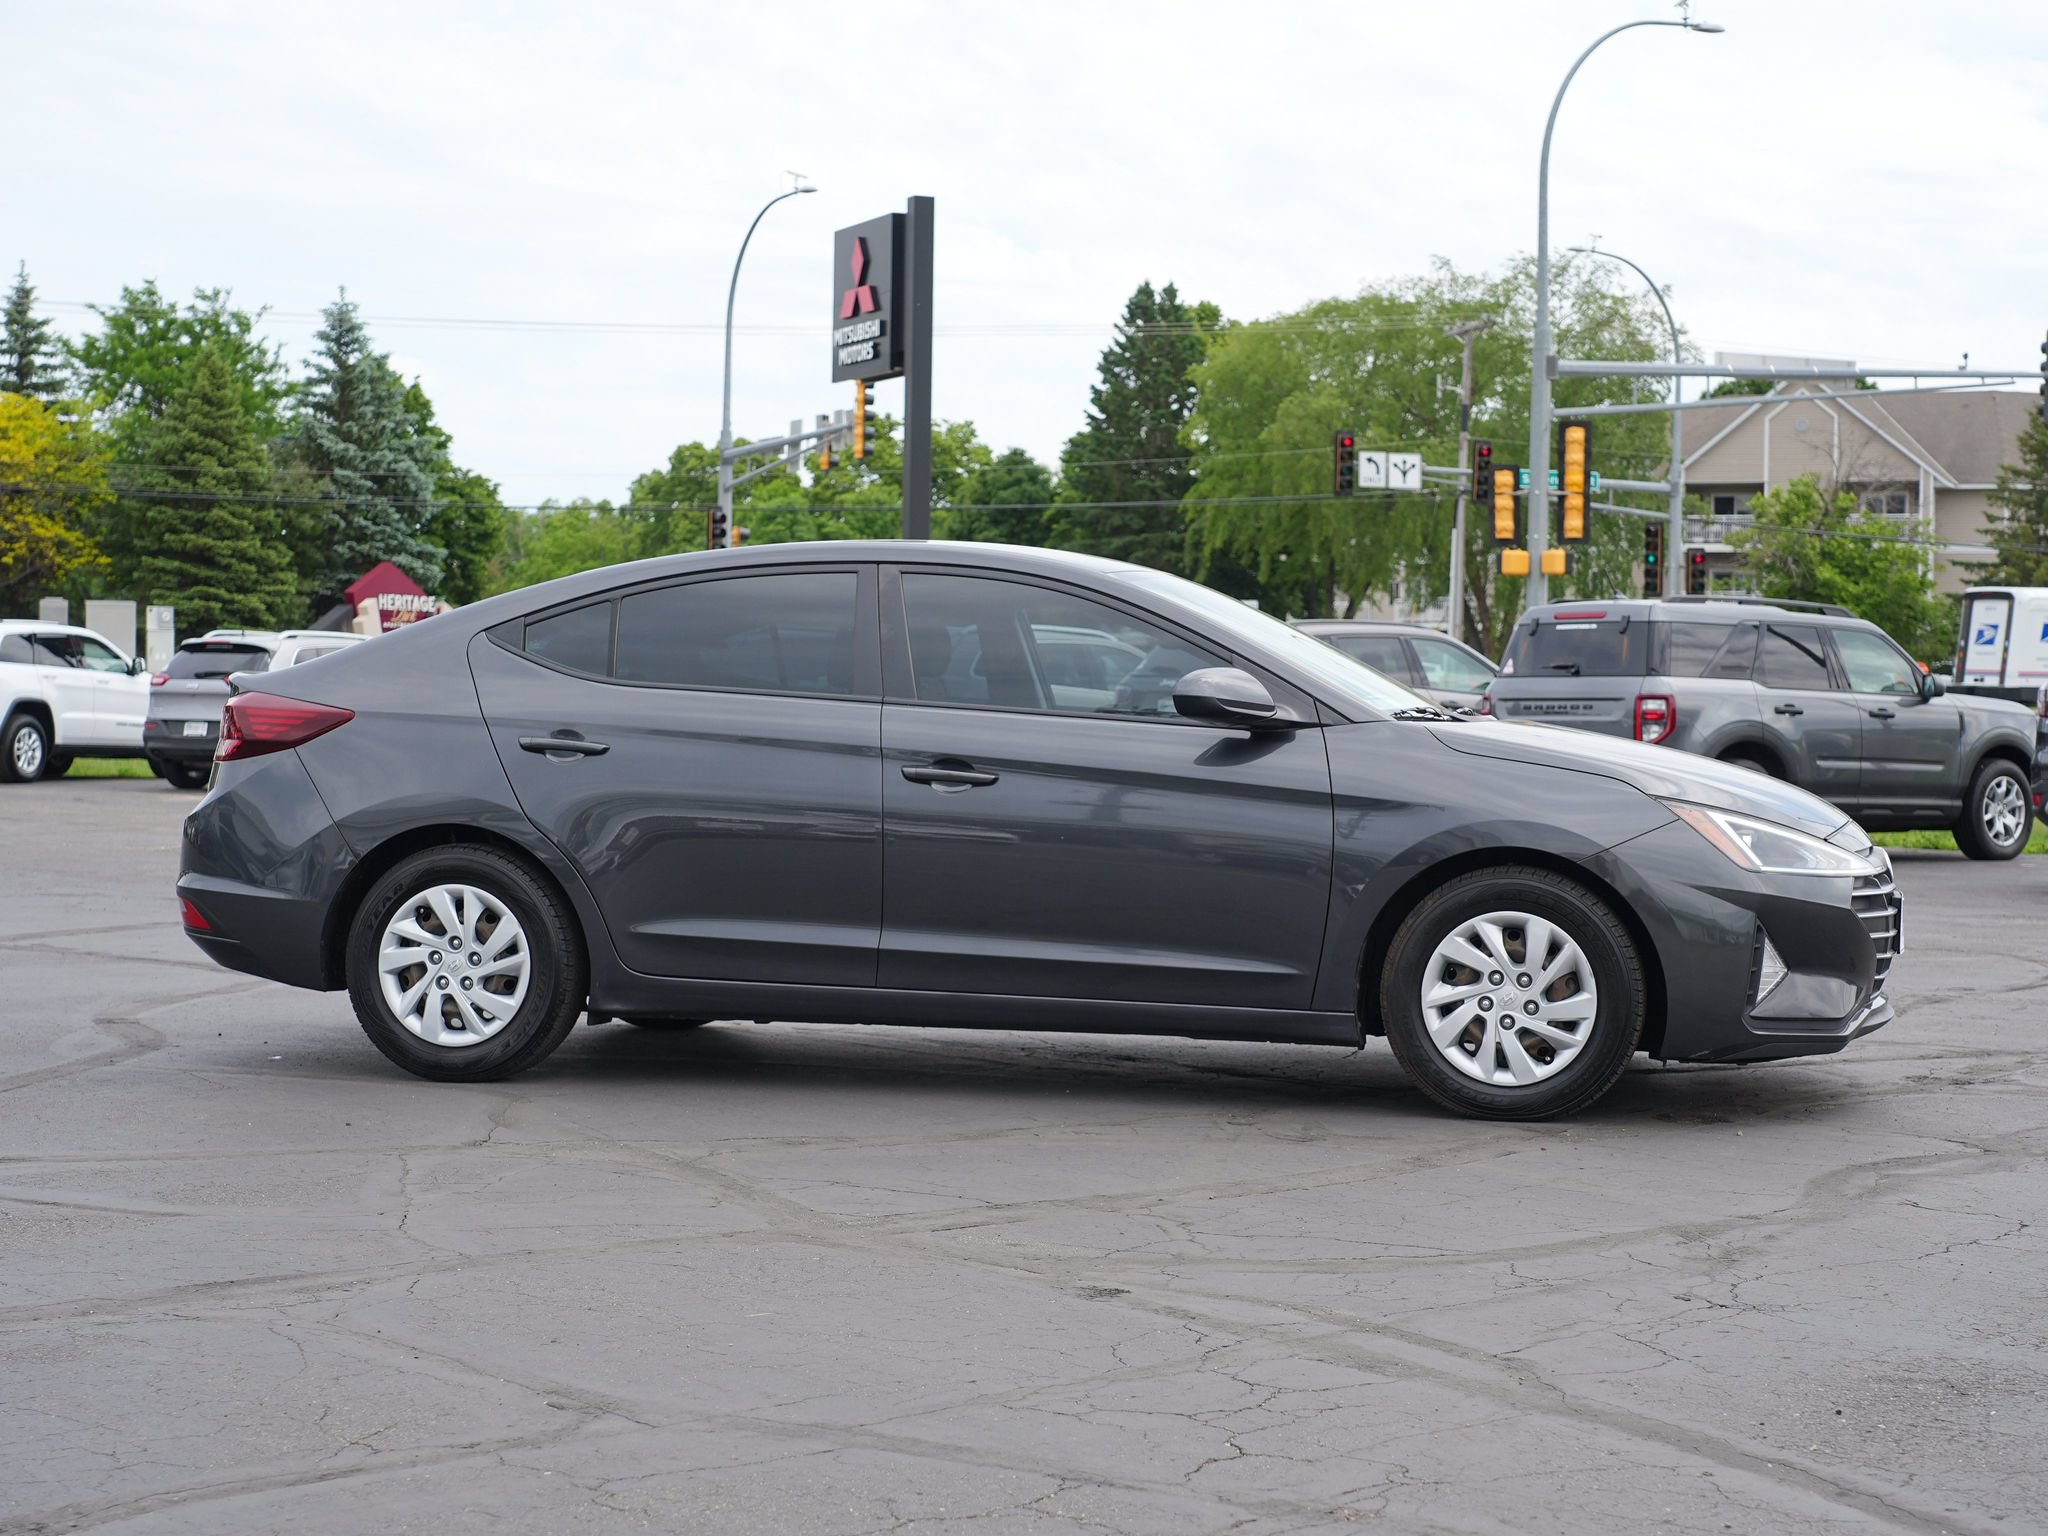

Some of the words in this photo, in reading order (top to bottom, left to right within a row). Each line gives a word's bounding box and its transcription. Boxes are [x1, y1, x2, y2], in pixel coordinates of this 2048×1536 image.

[834, 319, 880, 346] MITSUBISHI
[839, 341, 874, 366] MOTORS
[378, 593, 436, 612] HERITAGE
